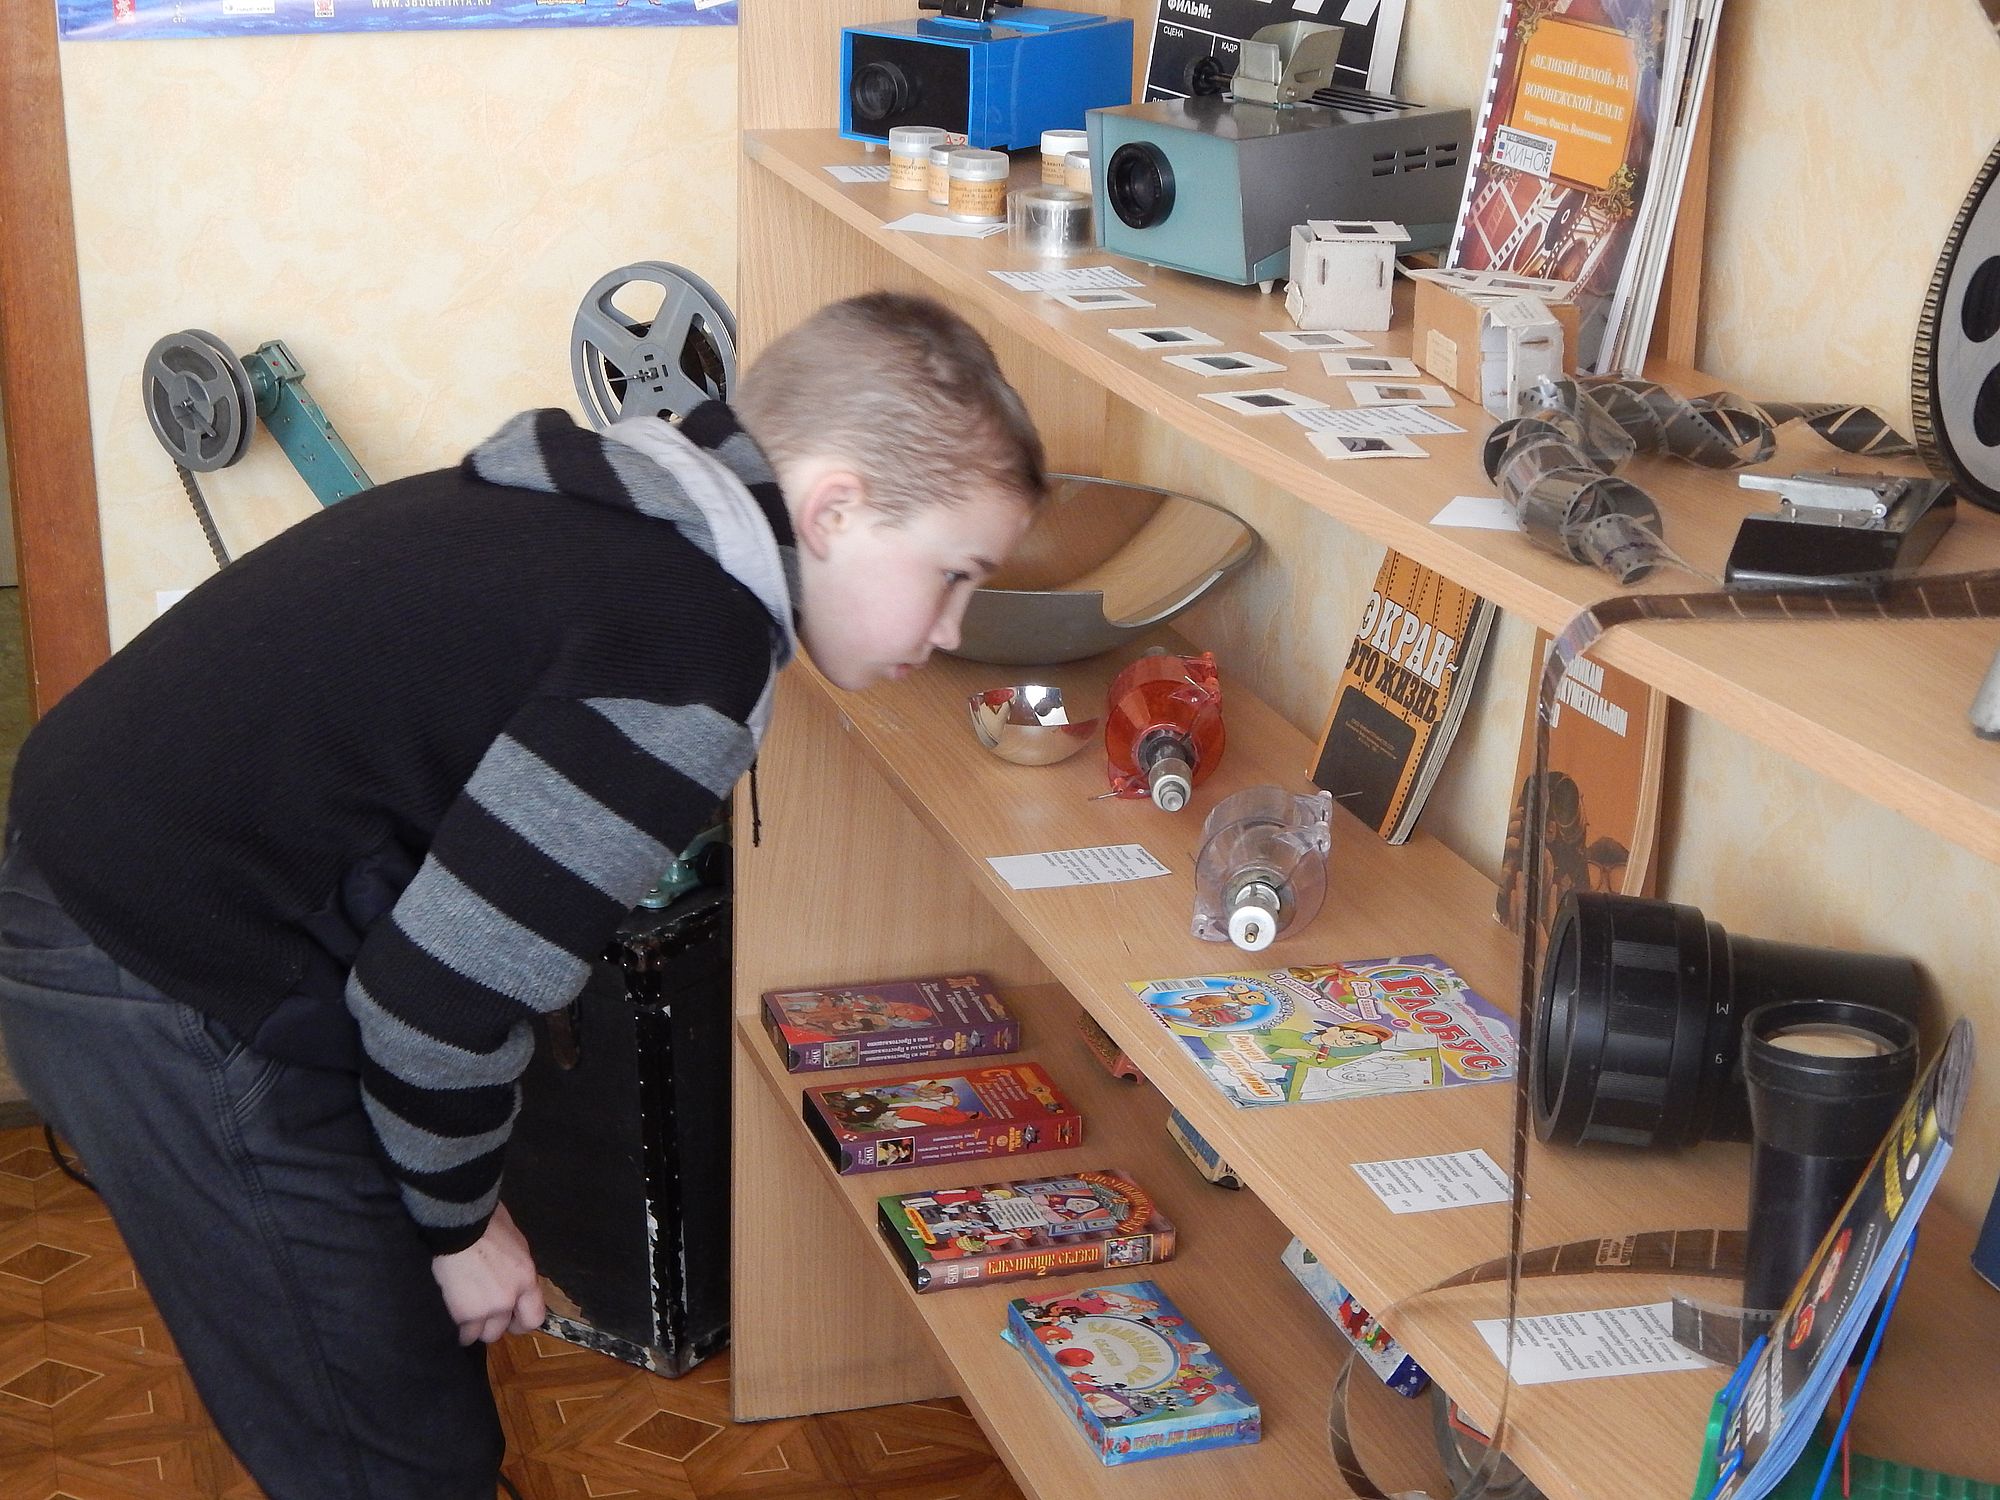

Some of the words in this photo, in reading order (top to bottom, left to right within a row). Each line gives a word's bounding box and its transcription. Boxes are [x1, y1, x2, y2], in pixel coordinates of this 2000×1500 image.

[1163, 25, 1185, 39] СЦЕНА
[1220, 41, 1239, 53] КАДР
[1616, 72, 1630, 91] НА
[1524, 82, 1594, 113] ВОРОНЕЖСКОЙ
[1593, 102, 1625, 121] ЗЕМЛЕ
[1503, 143, 1544, 171] КИНО
[1345, 637, 1380, 685] ЭТО
[1376, 663, 1442, 725] ЖИЗНЬ
[1374, 973, 1505, 1076] ГЛОБУС
[1057, 1247, 1099, 1265] СКАЗКИ
[1036, 1265, 1047, 1276] 2
